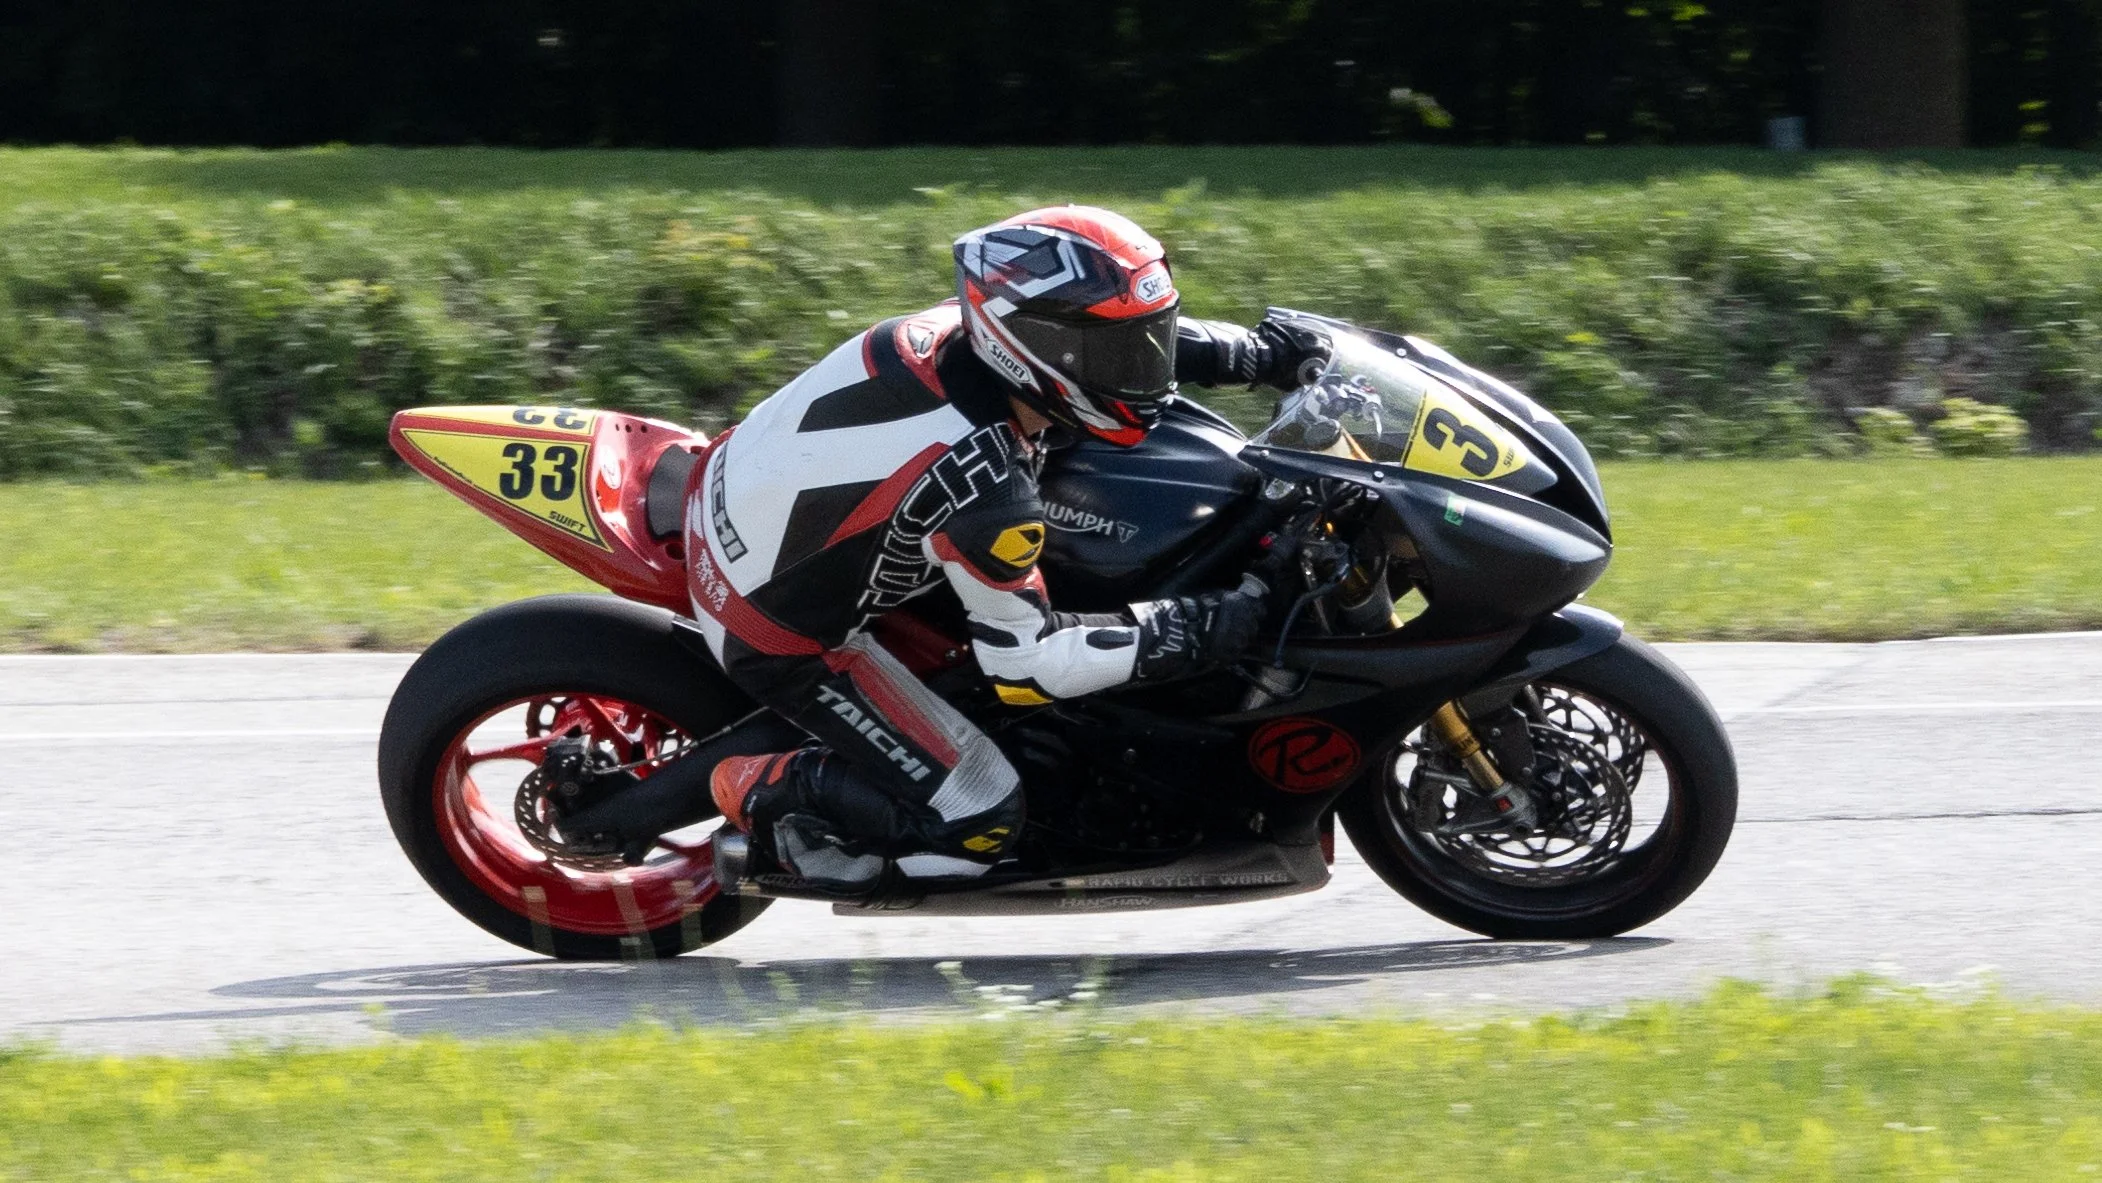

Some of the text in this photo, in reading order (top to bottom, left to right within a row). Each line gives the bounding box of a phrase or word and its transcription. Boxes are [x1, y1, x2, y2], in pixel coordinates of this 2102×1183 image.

[992, 342, 1025, 379] SHOEI
[500, 443, 578, 501] 33
[550, 510, 586, 533] SWIFT
[1042, 501, 1114, 536] IUMPH
[816, 685, 932, 781] TAICHI
